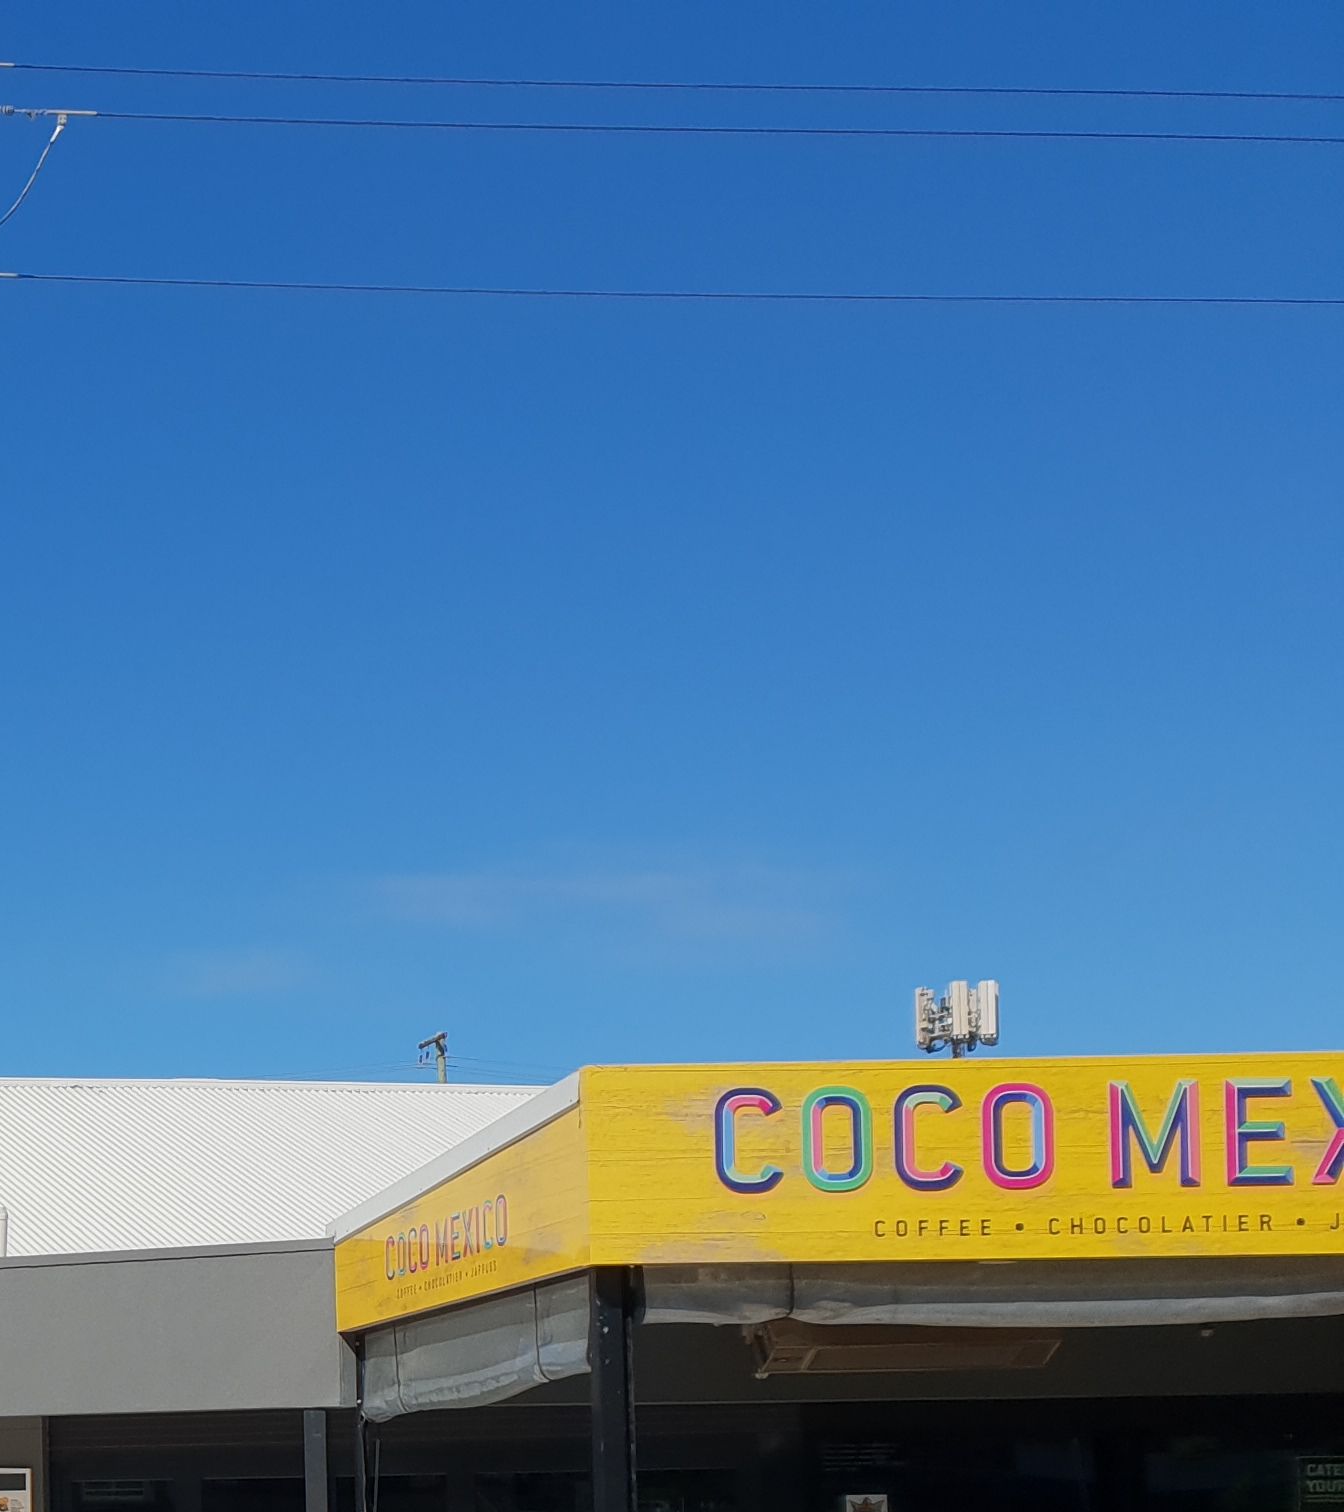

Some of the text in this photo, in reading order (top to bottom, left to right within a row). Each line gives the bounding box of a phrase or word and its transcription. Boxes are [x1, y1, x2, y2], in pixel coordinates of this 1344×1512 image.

[715, 1082, 1055, 1194] COCO
[385, 1194, 508, 1281] COCO MEXICO
[873, 1218, 999, 1239] COFFEE
[1047, 1213, 1275, 1235] CHOCOLATIER
[396, 1284, 417, 1299] COFFEE
